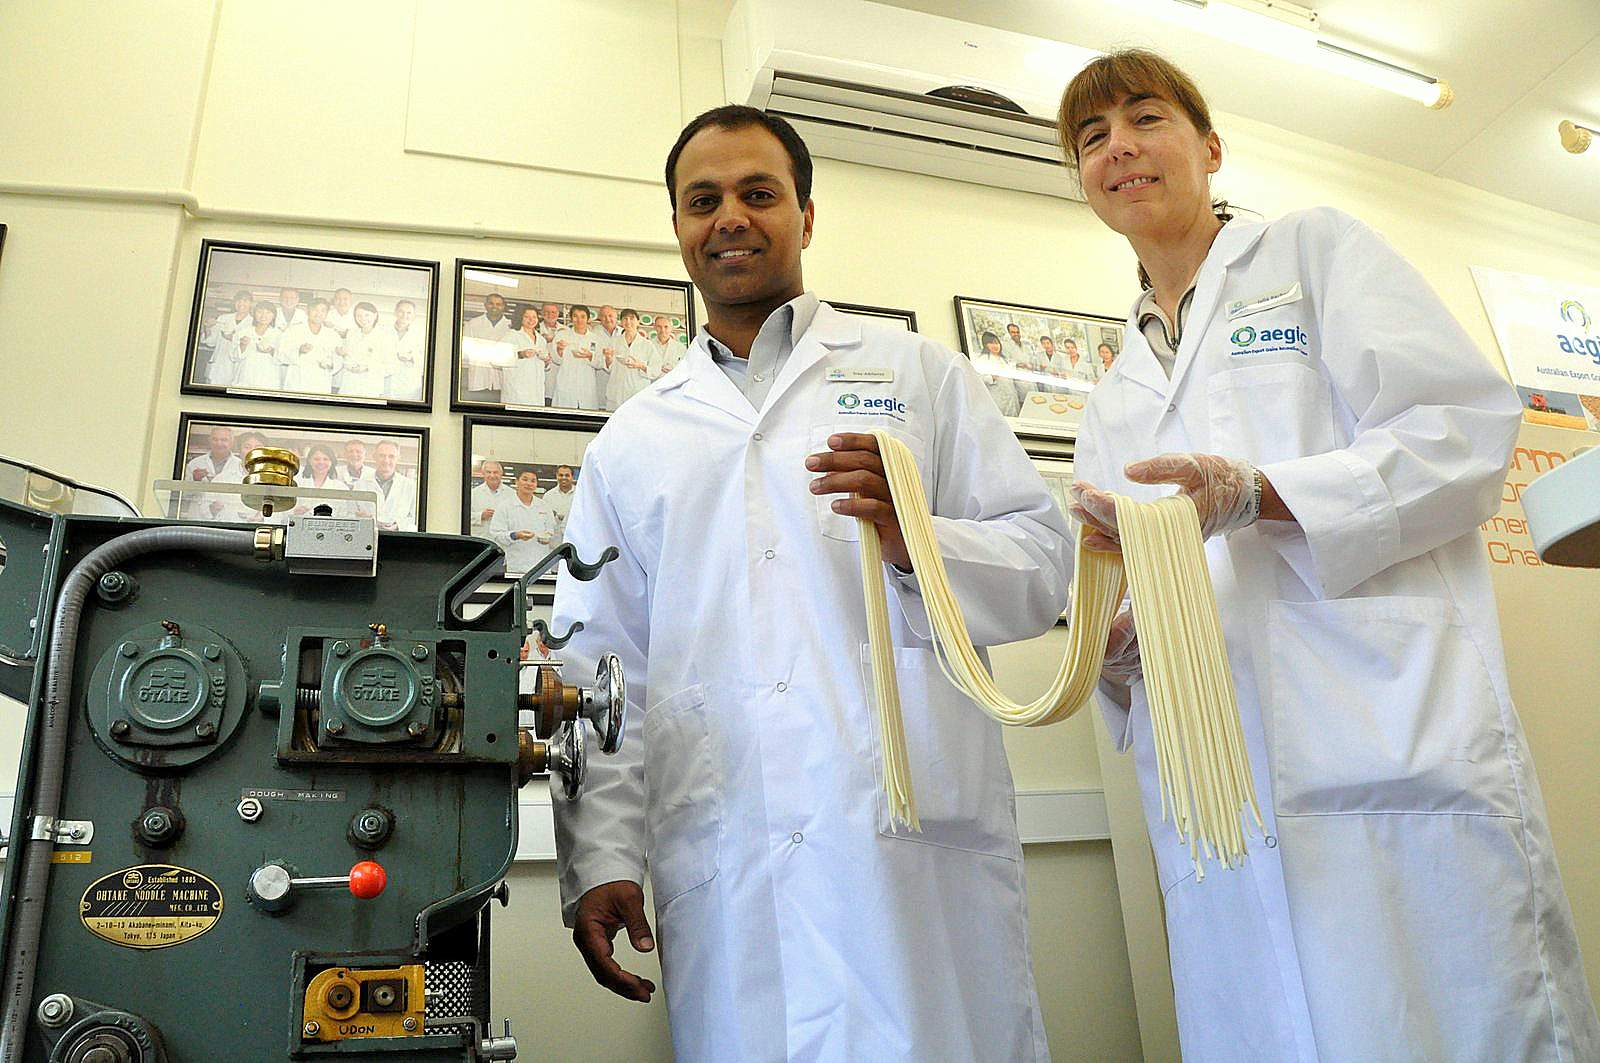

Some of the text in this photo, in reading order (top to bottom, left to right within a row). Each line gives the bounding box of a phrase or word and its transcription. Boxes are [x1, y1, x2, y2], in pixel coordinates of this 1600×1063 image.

[1260, 325, 1307, 345] aegic
[863, 397, 906, 413] aegic
[1487, 541, 1545, 567] Cha
[297, 791, 338, 799] MAKING
[147, 875, 179, 884] Established
[181, 876, 196, 884] 1885
[96, 890, 209, 901] OHTAKE NOODLE MACHINE
[339, 1024, 375, 1035] UDON
